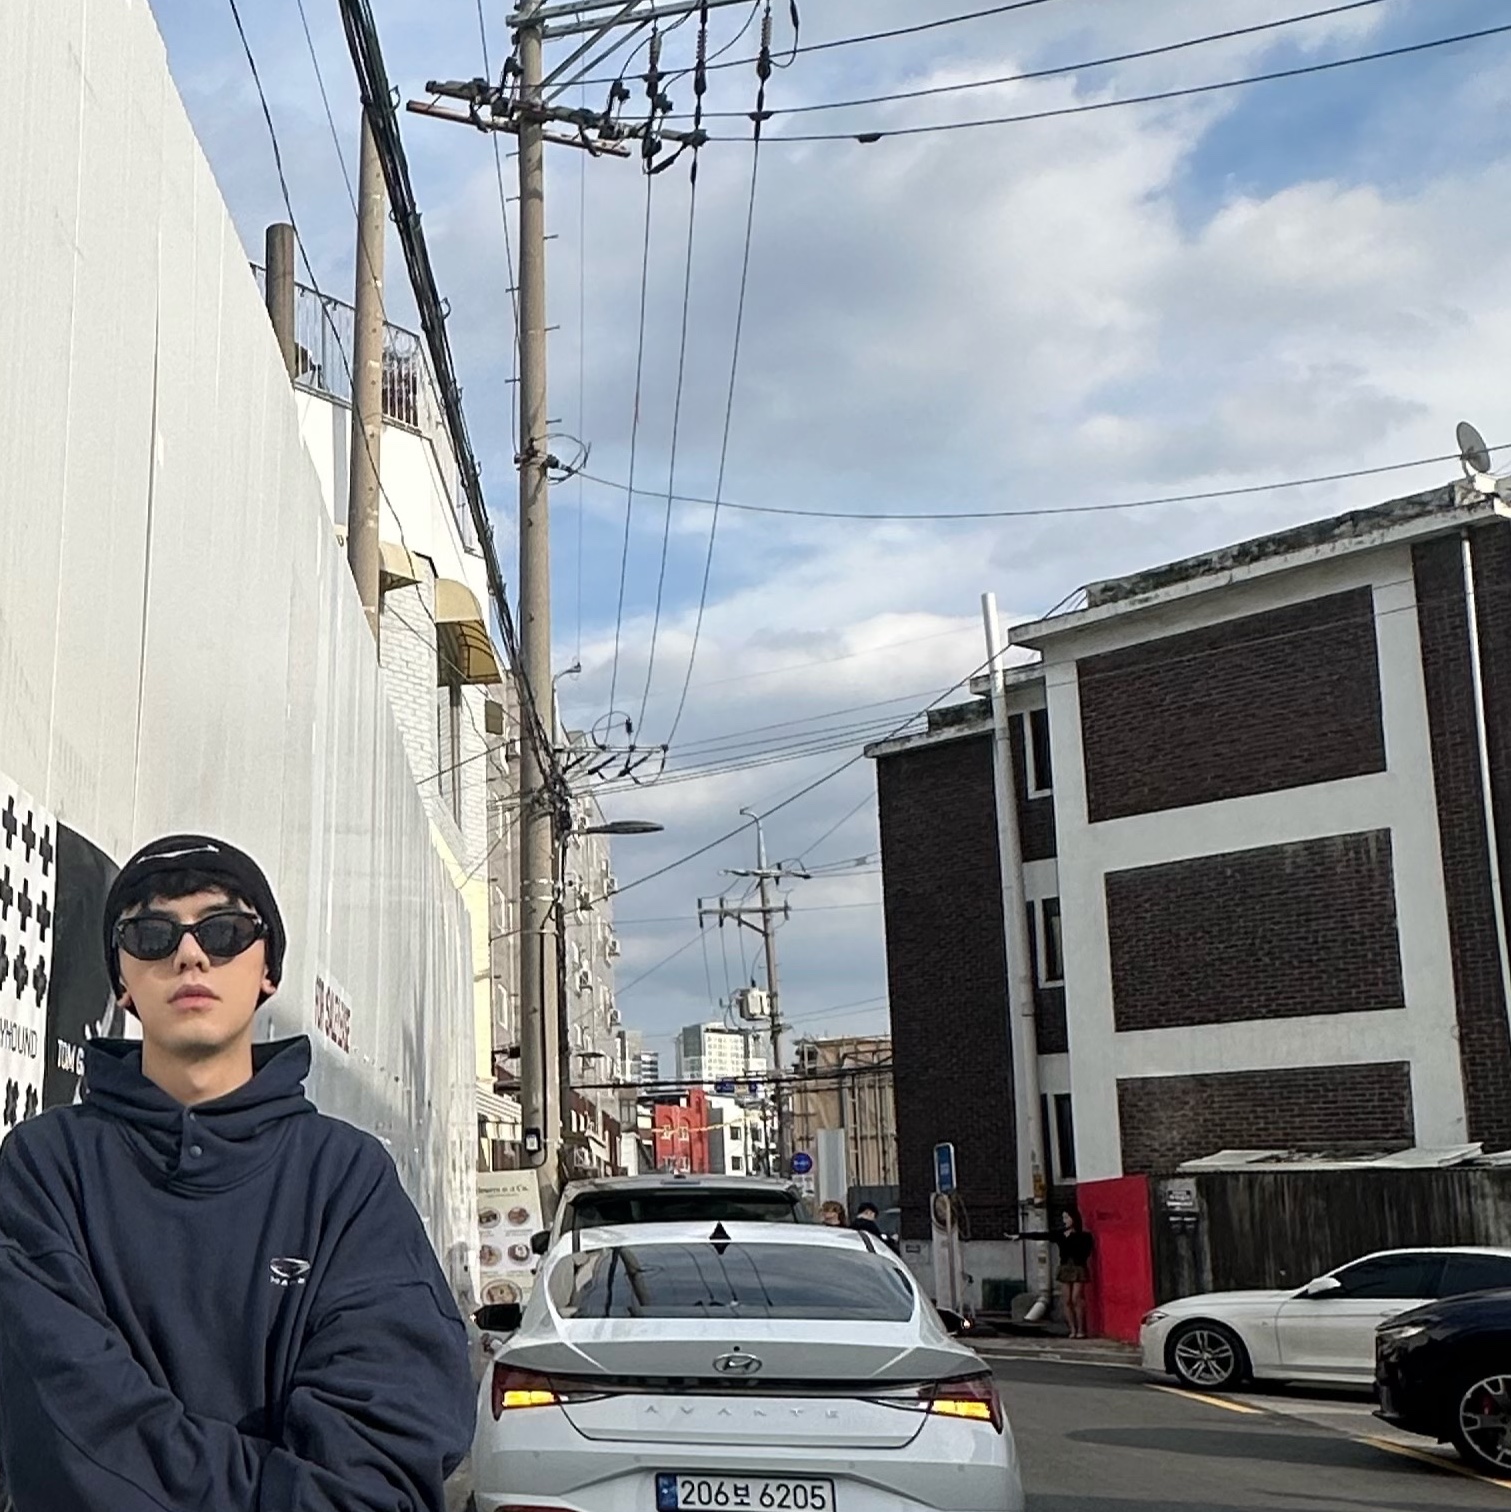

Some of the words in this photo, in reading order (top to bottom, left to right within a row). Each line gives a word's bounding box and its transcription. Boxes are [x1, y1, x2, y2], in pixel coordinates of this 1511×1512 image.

[57, 1038, 76, 1074] TOM
[645, 1405, 839, 1419] AVANTE
[680, 1480, 751, 1506] 206보
[759, 1482, 826, 1510] 6205
